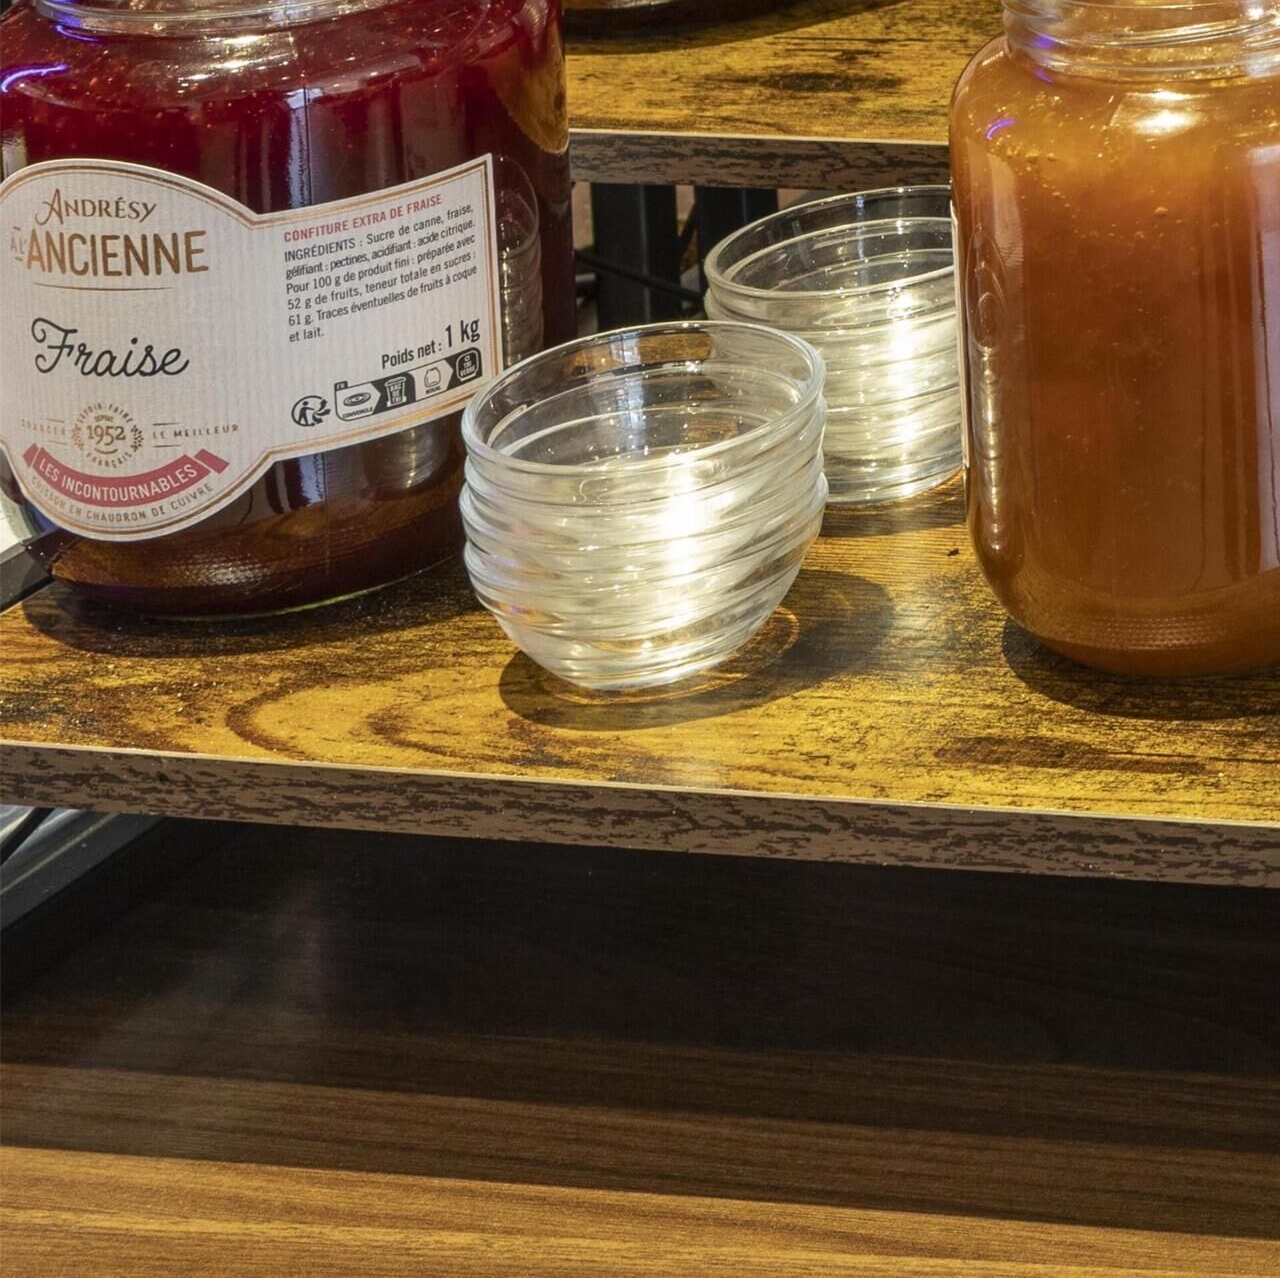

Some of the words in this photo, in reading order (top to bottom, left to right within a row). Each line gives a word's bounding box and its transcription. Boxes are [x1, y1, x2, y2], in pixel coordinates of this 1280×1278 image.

[35, 188, 158, 226] ANDRÉSY
[284, 220, 348, 243] CONFITURE
[352, 211, 387, 229] EXTRA
[390, 206, 403, 219] DE
[407, 193, 443, 215] FRAISE
[284, 238, 356, 262] INGRÉDIENTS
[366, 229, 394, 245] Sucre
[398, 225, 410, 236] de
[413, 217, 444, 232] canne,
[447, 203, 474, 220] fraise,
[286, 263, 323, 280] gélifiant
[330, 254, 370, 272] pectines,
[372, 241, 412, 260] acidifiant
[417, 232, 439, 246] acide
[441, 219, 475, 238] citrique.
[286, 281, 309, 294] Pour
[313, 275, 332, 289] 100
[334, 274, 341, 287] g
[344, 271, 355, 283] de
[358, 262, 392, 281] produit
[394, 256, 410, 269] fini
[417, 242, 454, 264] préparée
[456, 235, 475, 250] avec
[288, 297, 301, 310] 52
[305, 297, 311, 309] g
[315, 292, 327, 305] de
[331, 287, 362, 302] fruits,
[366, 277, 397, 293] teneur
[400, 268, 428, 284] totale
[430, 263, 441, 274] en
[444, 253, 471, 270] sucres
[288, 313, 301, 326] 61
[305, 313, 314, 325] g.
[317, 306, 348, 321] Traces
[351, 291, 405, 314] éventuelles
[407, 285, 419, 298] de
[420, 278, 443, 293] fruits
[446, 275, 450, 286] à
[453, 265, 477, 283] coque
[31, 317, 190, 378] Fraise
[289, 330, 300, 342] et
[303, 326, 325, 339] lait.
[381, 347, 414, 370] Poids
[417, 340, 436, 358] net
[445, 324, 452, 347] 1
[460, 318, 481, 343] kg
[86, 425, 126, 446] 1952
[174, 424, 240, 438] MEILLEUR
[39, 456, 58, 482] LES
[61, 464, 198, 502] INCONTOURNABLES
[69, 505, 82, 516] EN
[86, 511, 146, 523] CHAUDRON
[152, 506, 166, 517] DE
[170, 482, 214, 511] CUIVRE
